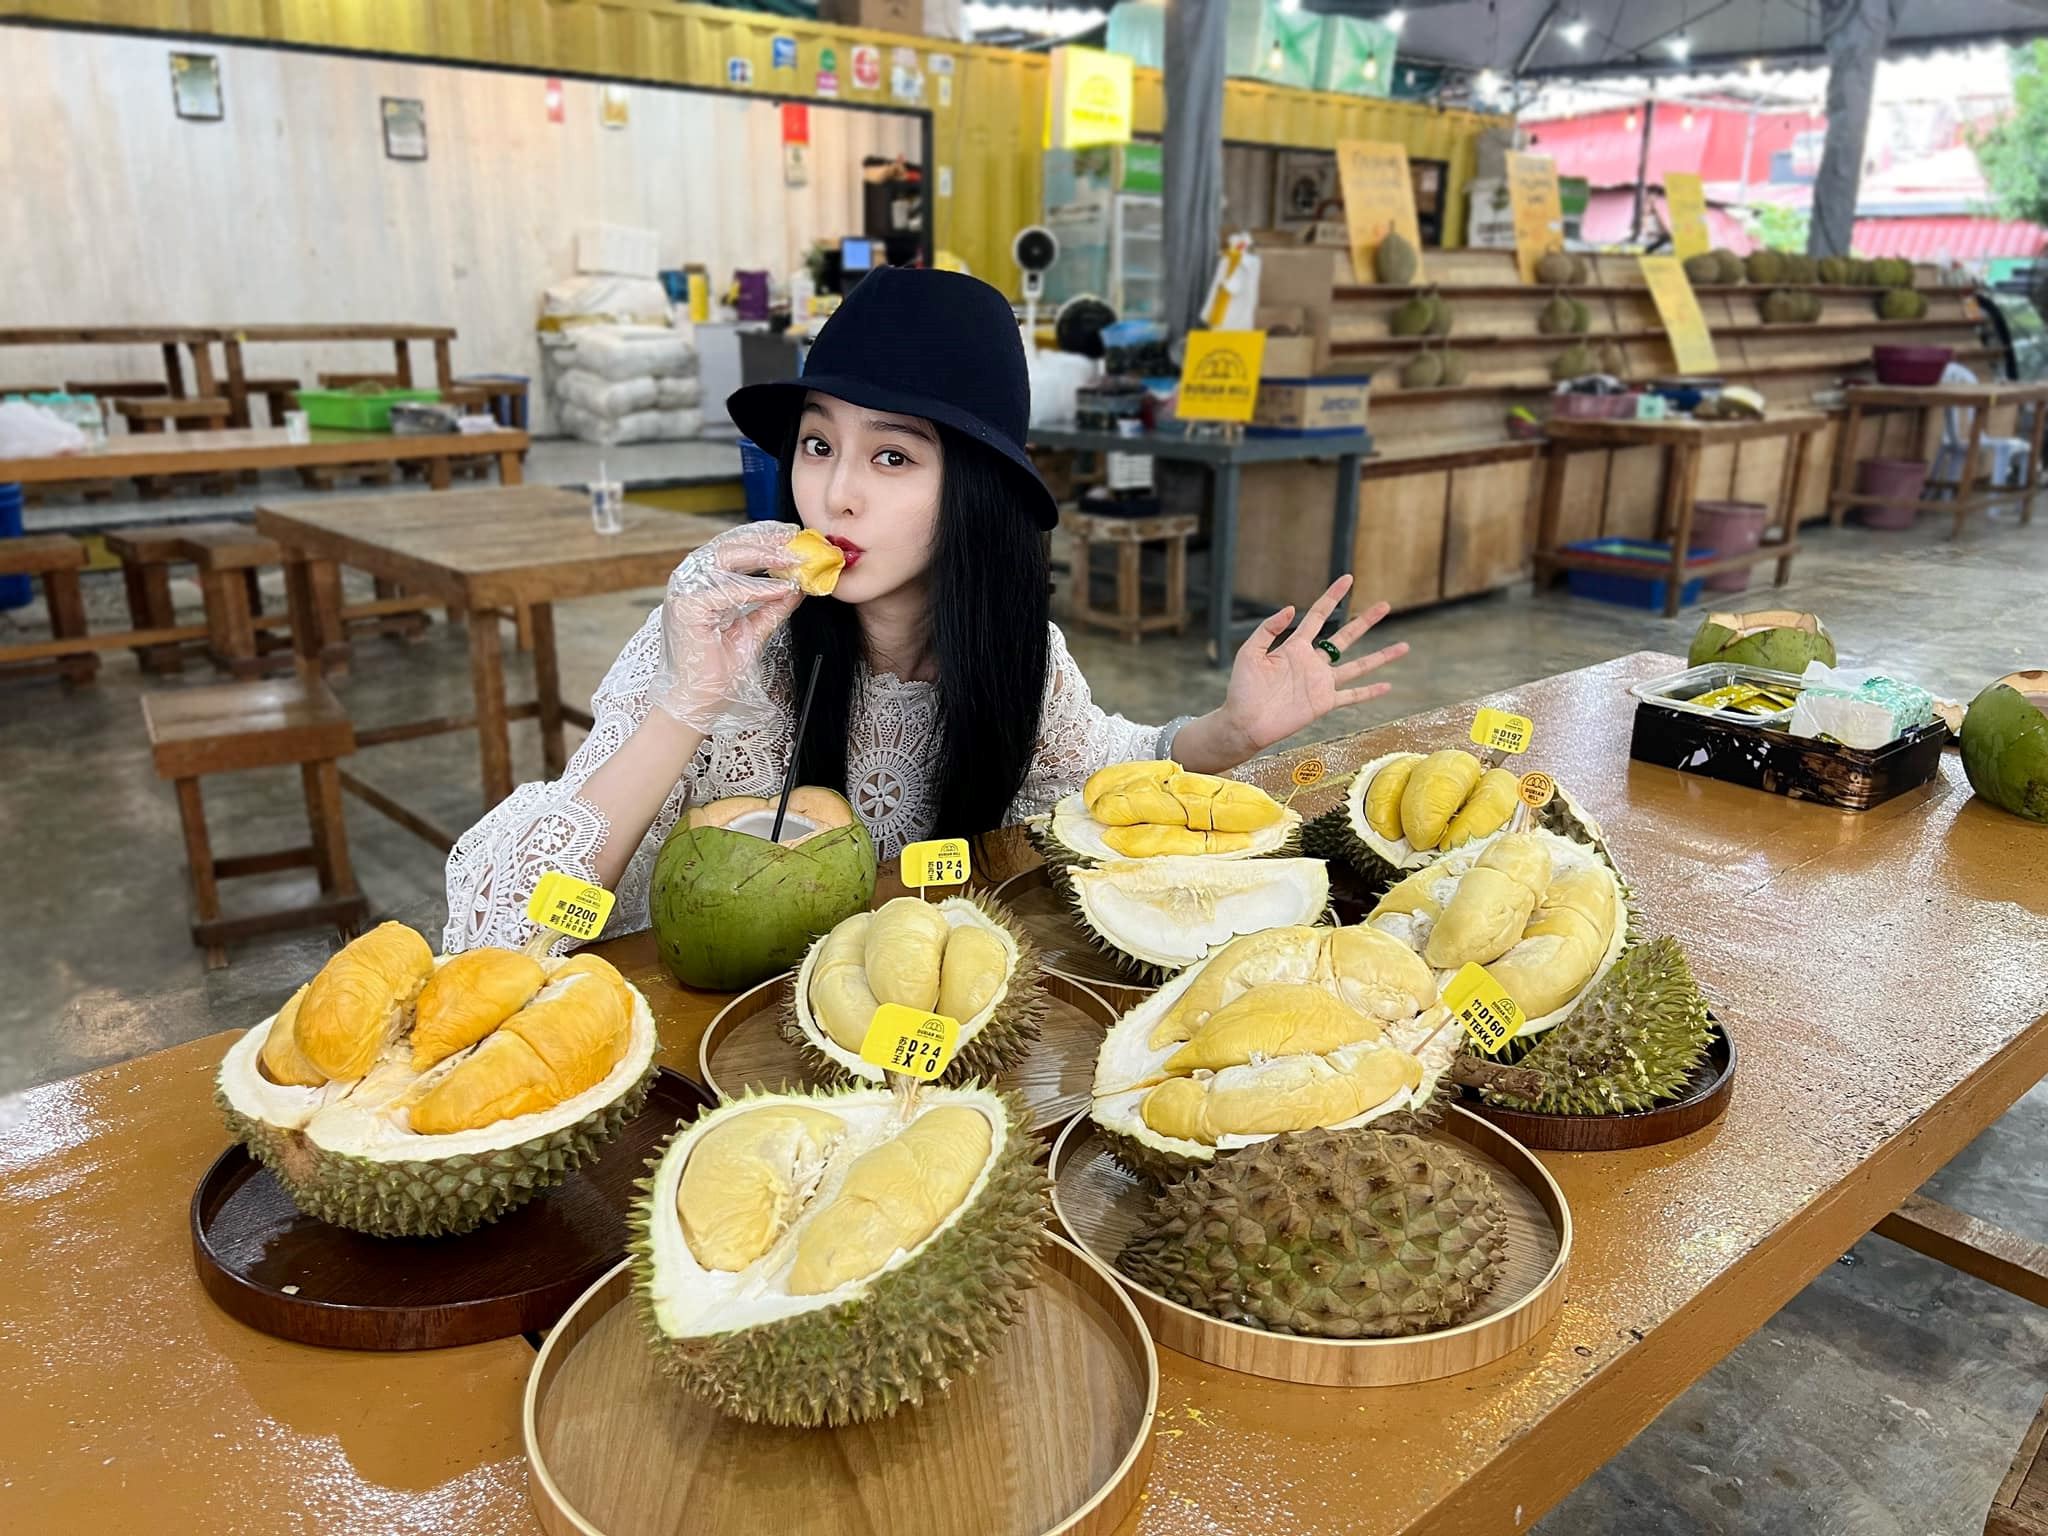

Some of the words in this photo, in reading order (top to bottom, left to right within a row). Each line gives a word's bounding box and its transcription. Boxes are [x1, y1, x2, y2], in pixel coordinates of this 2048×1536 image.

[1500, 729, 1522, 742] D197
[1525, 788, 1545, 797] DURIAN
[936, 859, 962, 870] D24
[566, 903, 598, 923] D200
[560, 920, 590, 937] THORN
[563, 914, 594, 930] BLACK
[1478, 1007, 1506, 1038] D160
[1469, 1017, 1495, 1049] TEKKA
[908, 1039, 942, 1059] D24
